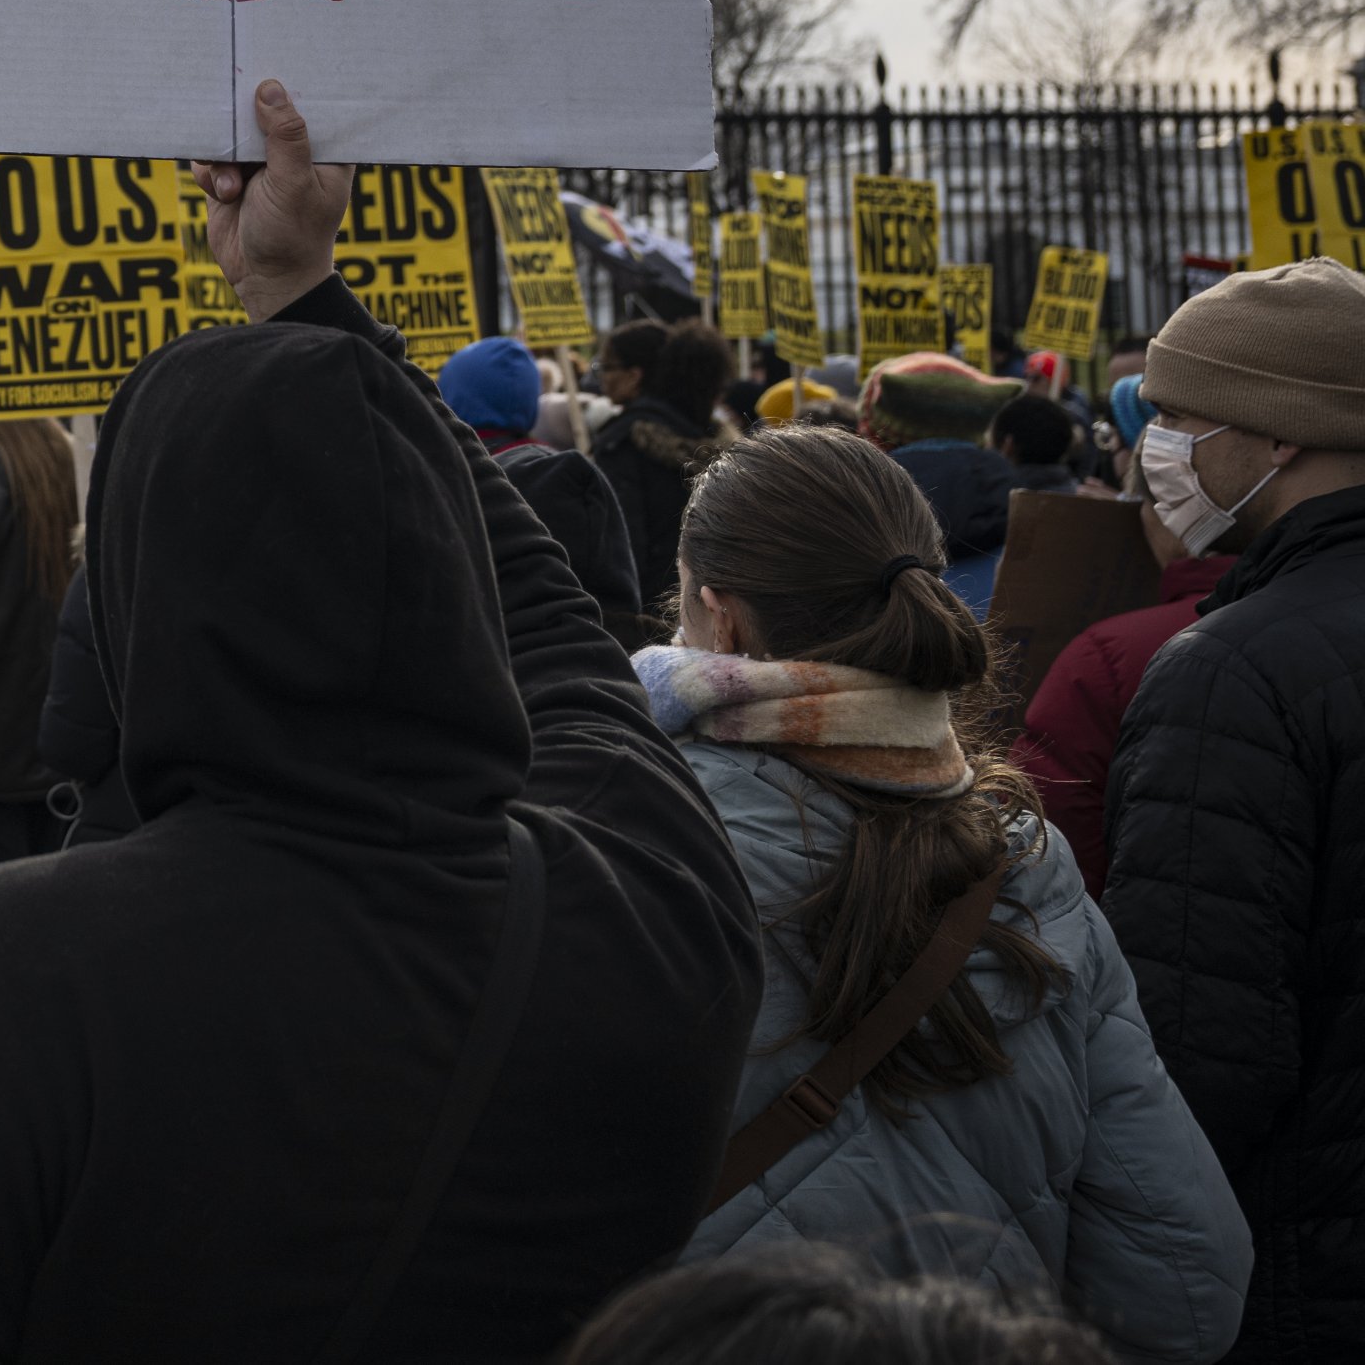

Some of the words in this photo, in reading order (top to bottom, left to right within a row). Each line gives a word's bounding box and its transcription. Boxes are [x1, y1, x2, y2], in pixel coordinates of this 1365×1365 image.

[51, 156, 176, 247] U.S.
[495, 183, 564, 243] NEEDS
[859, 210, 935, 277] NEEDS
[511, 253, 553, 275] NOT
[418, 272, 465, 284] THE
[51, 300, 92, 315] ON
[861, 287, 924, 310] NOT
[8, 385, 31, 407] FOR
[32, 381, 99, 405] SOCIALISM
